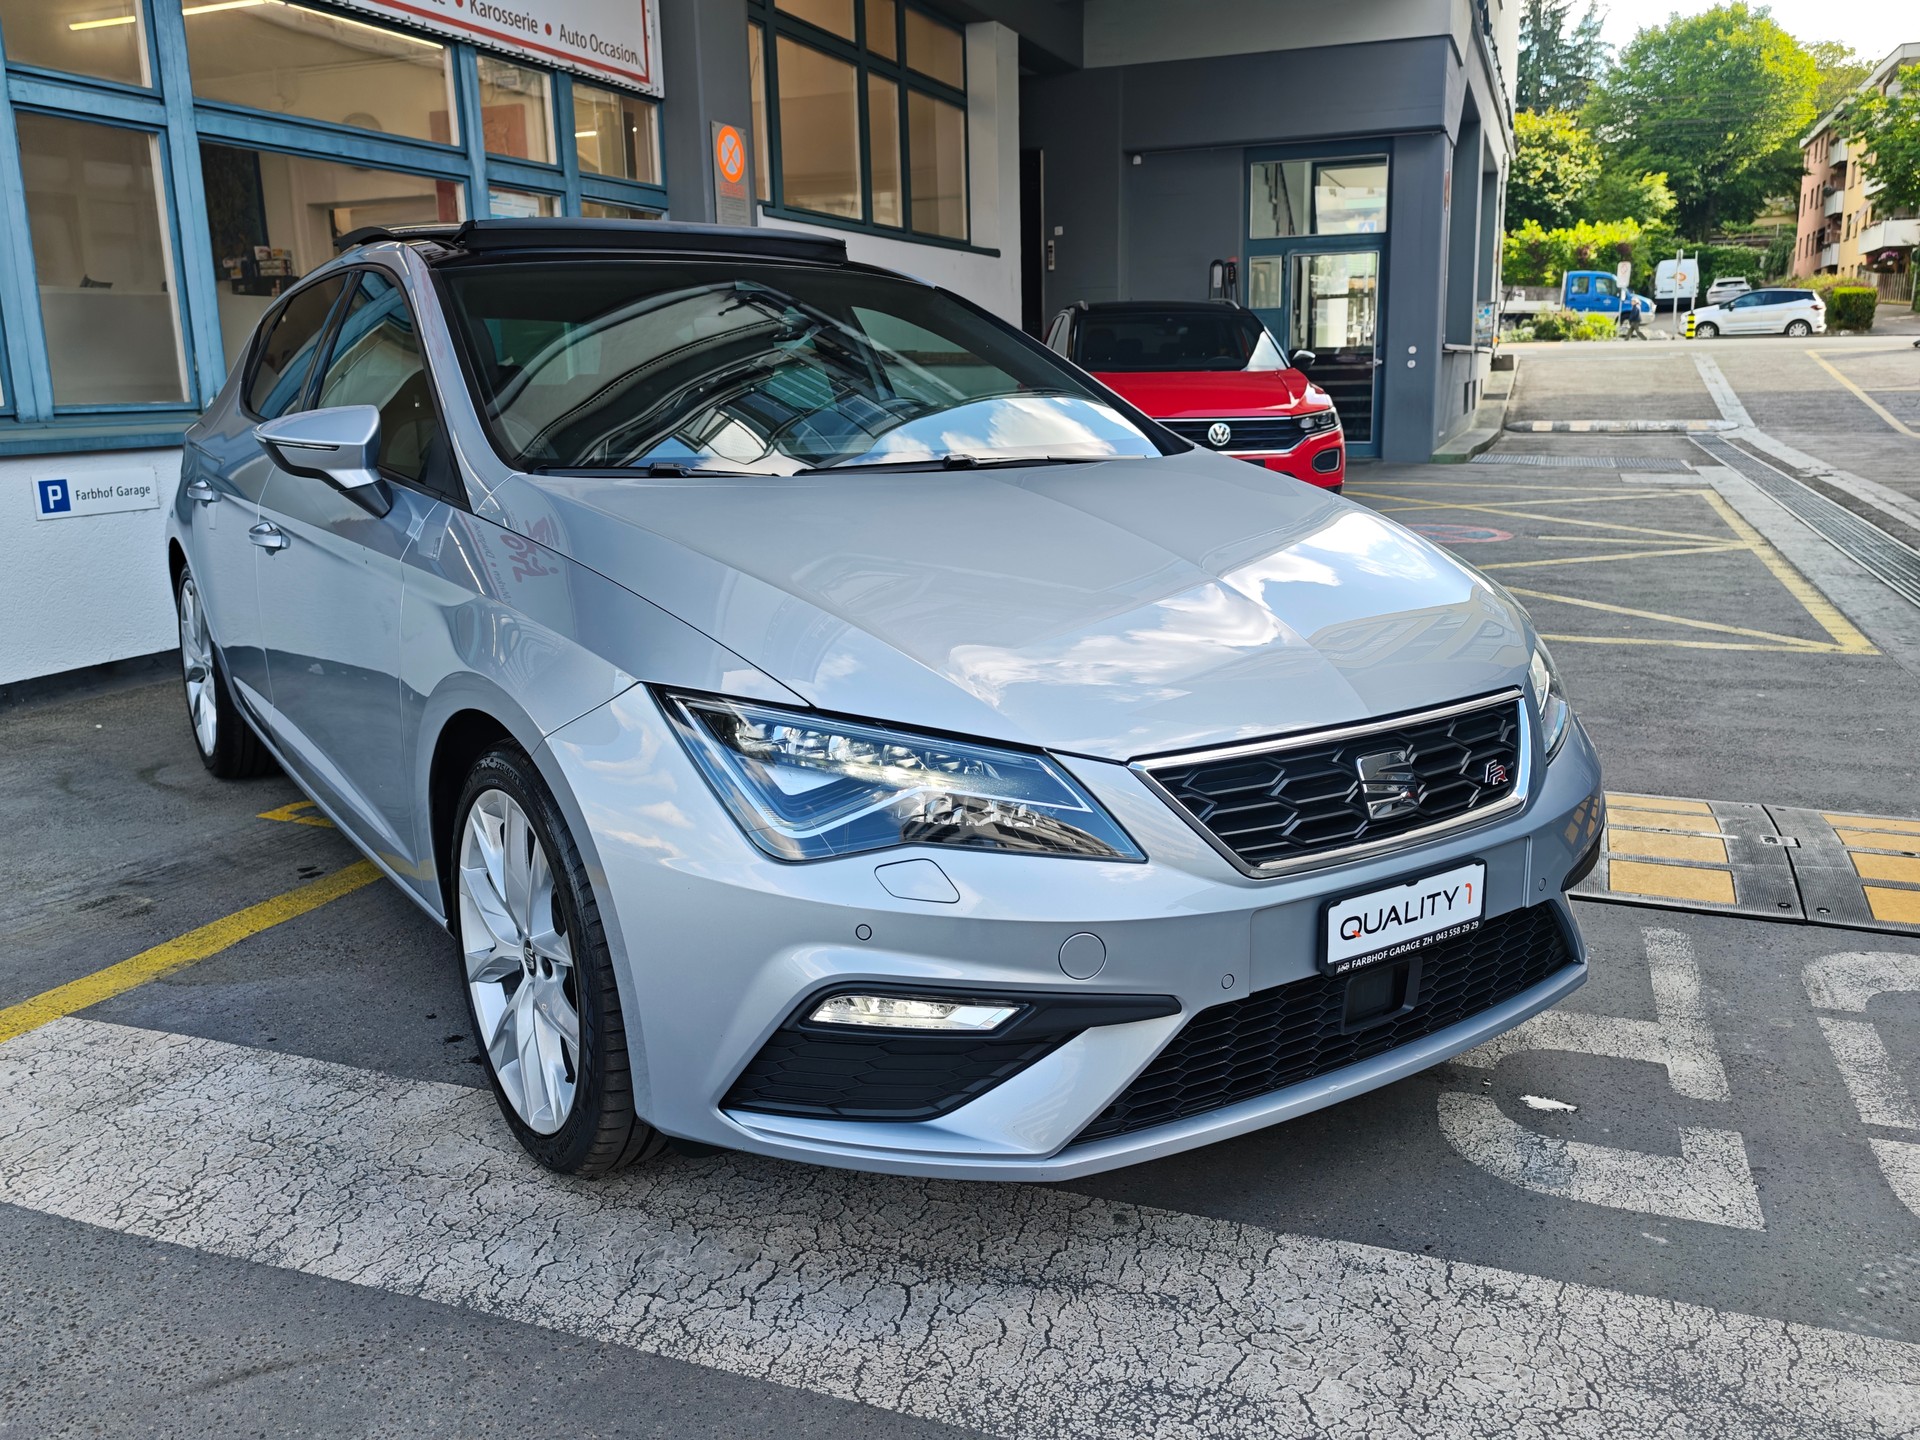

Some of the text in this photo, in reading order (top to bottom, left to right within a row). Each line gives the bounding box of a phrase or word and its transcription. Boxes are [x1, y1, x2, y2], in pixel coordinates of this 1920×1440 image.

[470, 0, 638, 65] Karosserie Auto Occasion
[47, 485, 151, 510] P Farbhof Garage
[1340, 882, 1473, 941] QUALITY 1
[1351, 920, 1479, 969] FARBHOF GARAGE ZH 043 558 29 29
